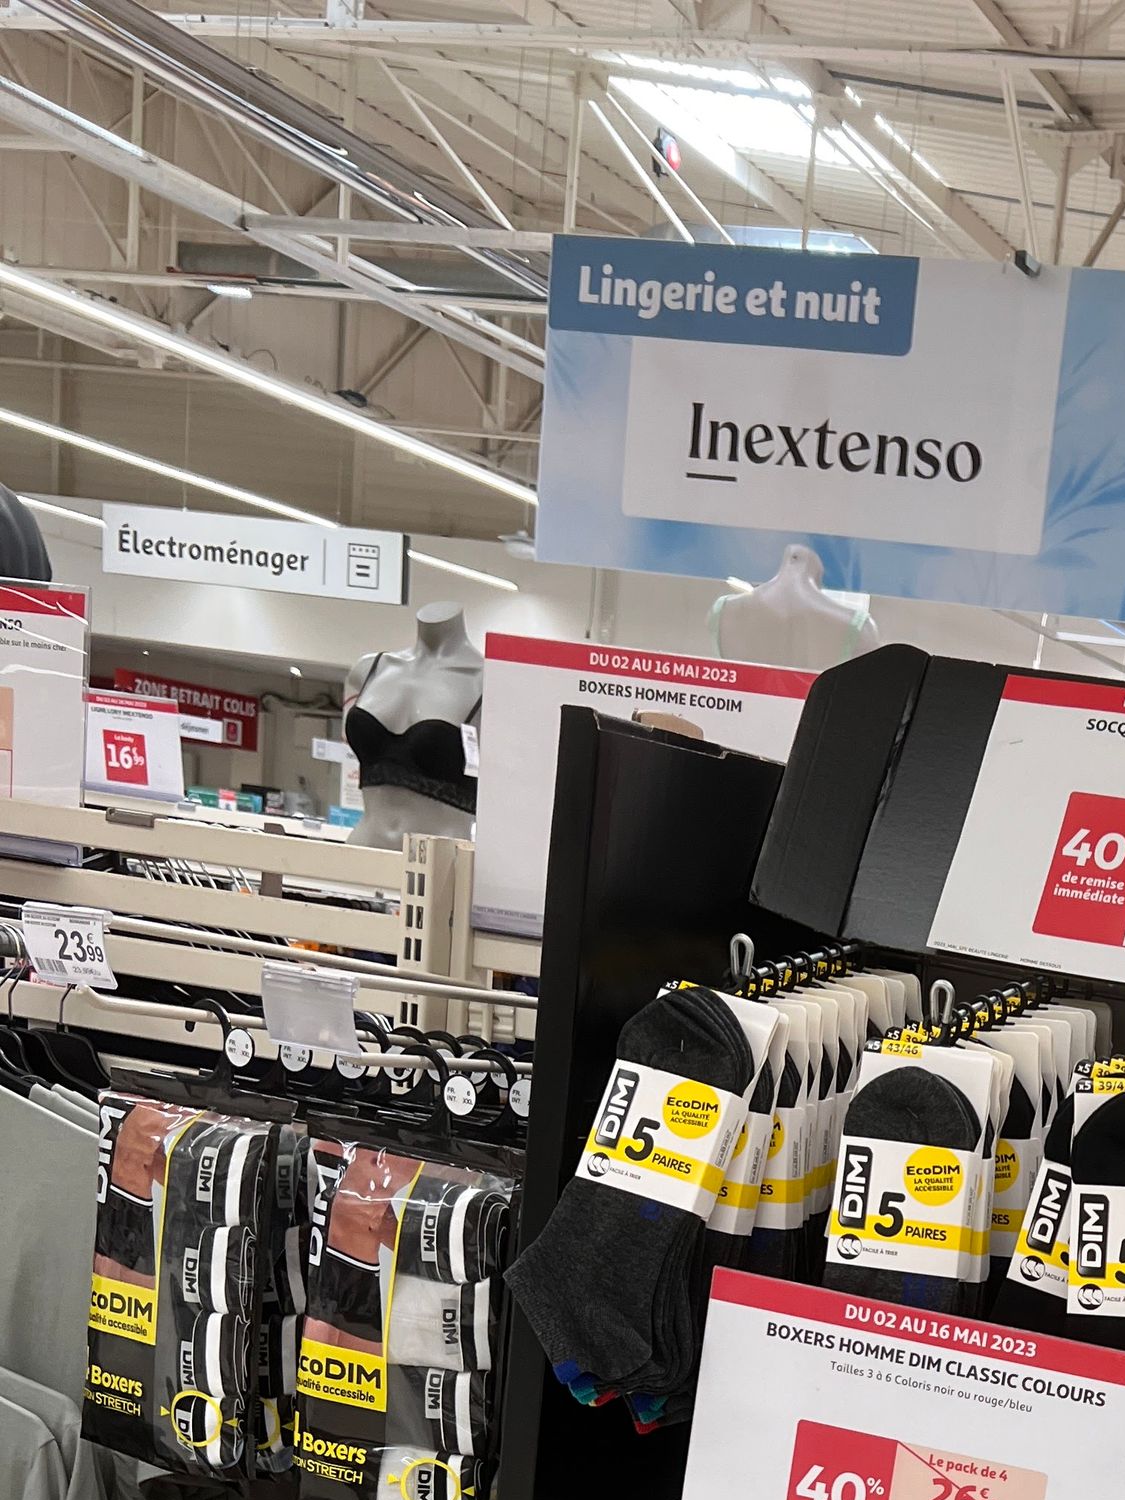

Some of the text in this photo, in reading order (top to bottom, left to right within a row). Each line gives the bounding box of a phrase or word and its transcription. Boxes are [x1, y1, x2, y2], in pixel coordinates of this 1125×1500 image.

[579, 264, 880, 325] Lingerie et nuit
[687, 402, 982, 483] Inextenso
[117, 523, 309, 576] Électroménager
[589, 652, 737, 683] DU 02 AU 16 MAI 2023
[134, 678, 167, 699] ZONE
[171, 687, 221, 710] RETRAIT
[223, 698, 256, 717] COLIS
[579, 679, 742, 713] BOXERS HOMME ECODIM
[1053, 884, 1125, 907] immédiate
[1062, 872, 1124, 890] de remise
[885, 1041, 920, 1056] 43/46
[600, 1077, 636, 1139] DIM
[666, 1096, 719, 1113] EcoDIM
[681, 1110, 710, 1121] QUALITÉ
[625, 1117, 692, 1175] 5 PAIRES
[906, 1163, 960, 1177] EcoDIM
[1082, 1199, 1105, 1270] DIM
[845, 1304, 1037, 1358] DU 02 AU 16 MAI 2023
[766, 1321, 1106, 1408] BOXERS HOMME DIM CLASSIC COLOURS
[831, 1360, 1033, 1414] Tailles 3 à 6 Coloris noir ou rouge/bleu
[929, 1454, 1008, 1482] Le pack de 4
